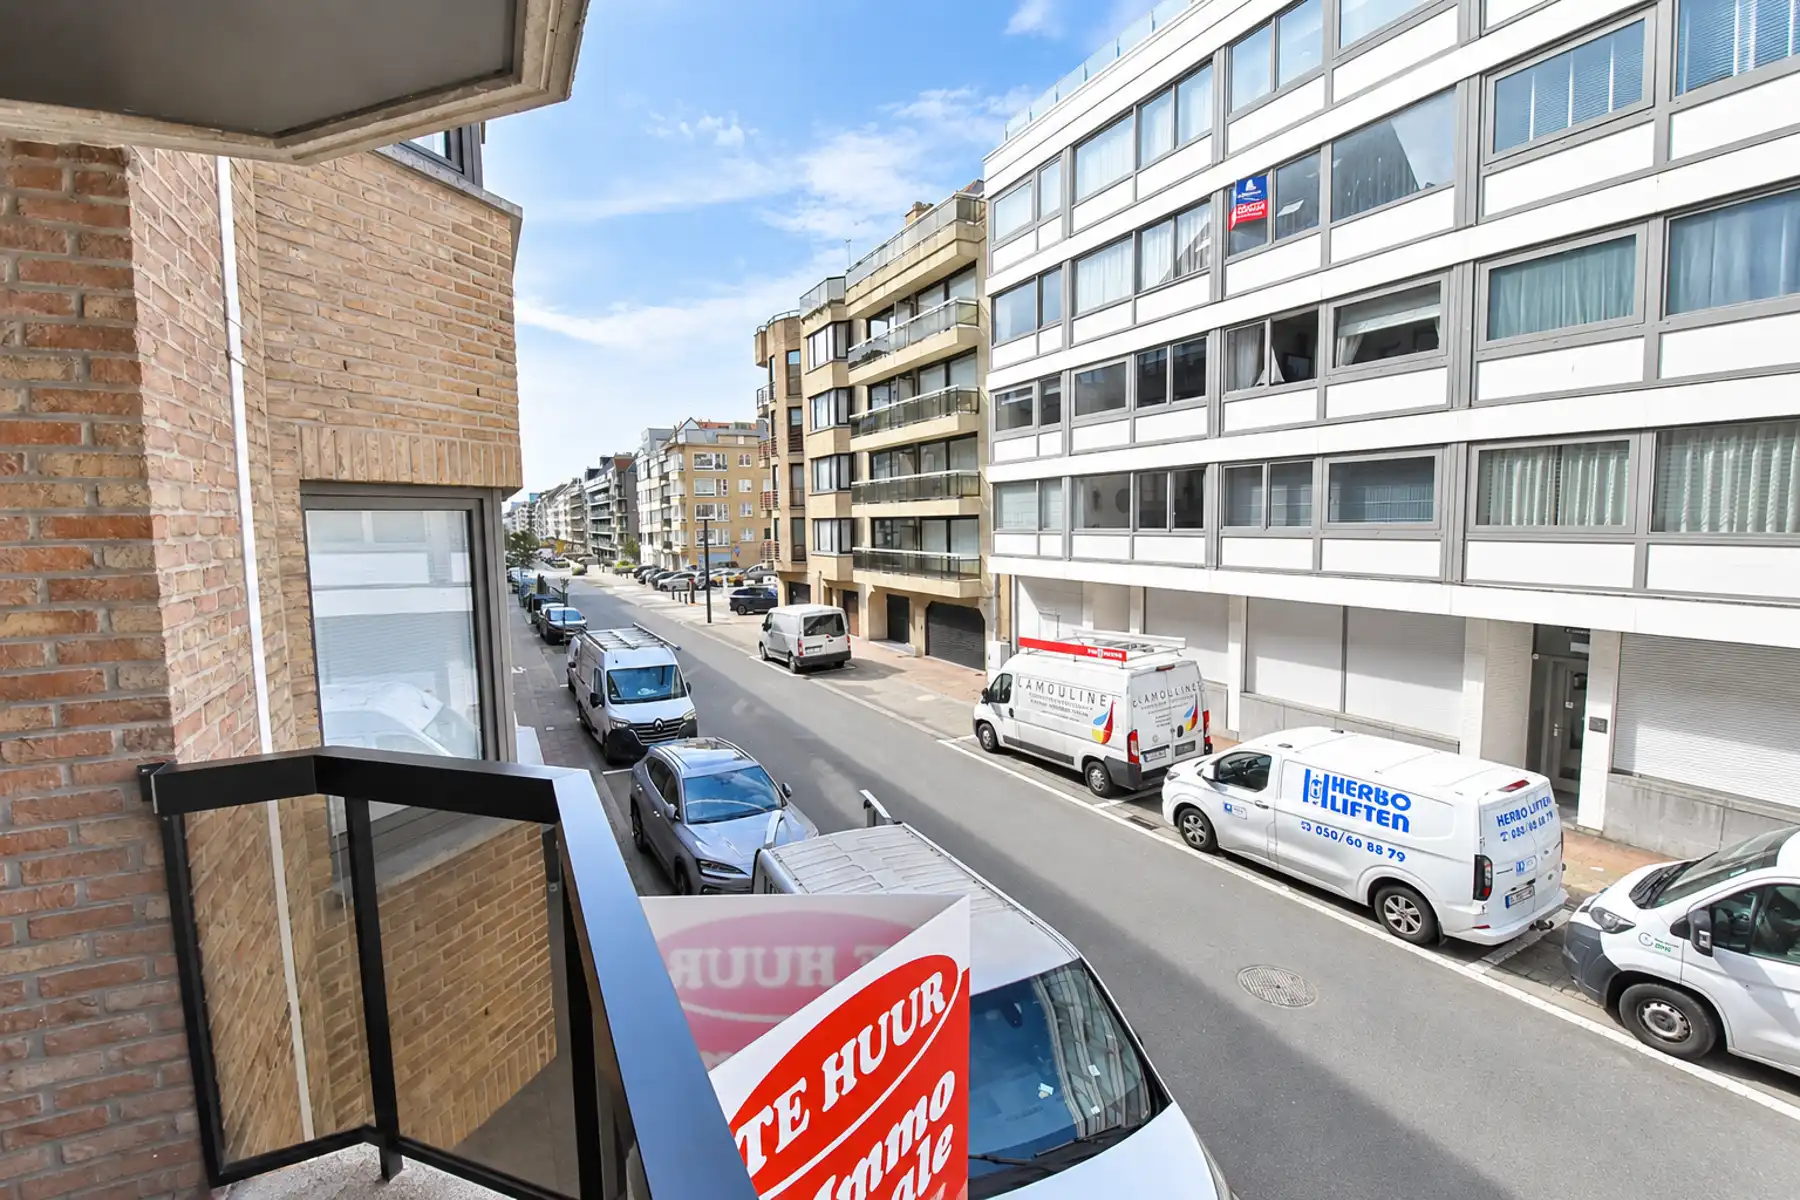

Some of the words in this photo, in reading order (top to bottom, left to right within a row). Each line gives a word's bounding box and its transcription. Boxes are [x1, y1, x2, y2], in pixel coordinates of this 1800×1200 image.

[1017, 676, 1107, 707] LAMOULINE
[1331, 776, 1411, 811] HERBO
[1330, 795, 1410, 833] LIFTEN
[1315, 825, 1362, 848] 050/60
[1367, 842, 1383, 855] 88
[1387, 847, 1405, 862] 79
[734, 1077, 810, 1178] TE
[821, 971, 947, 1112] HUUR
